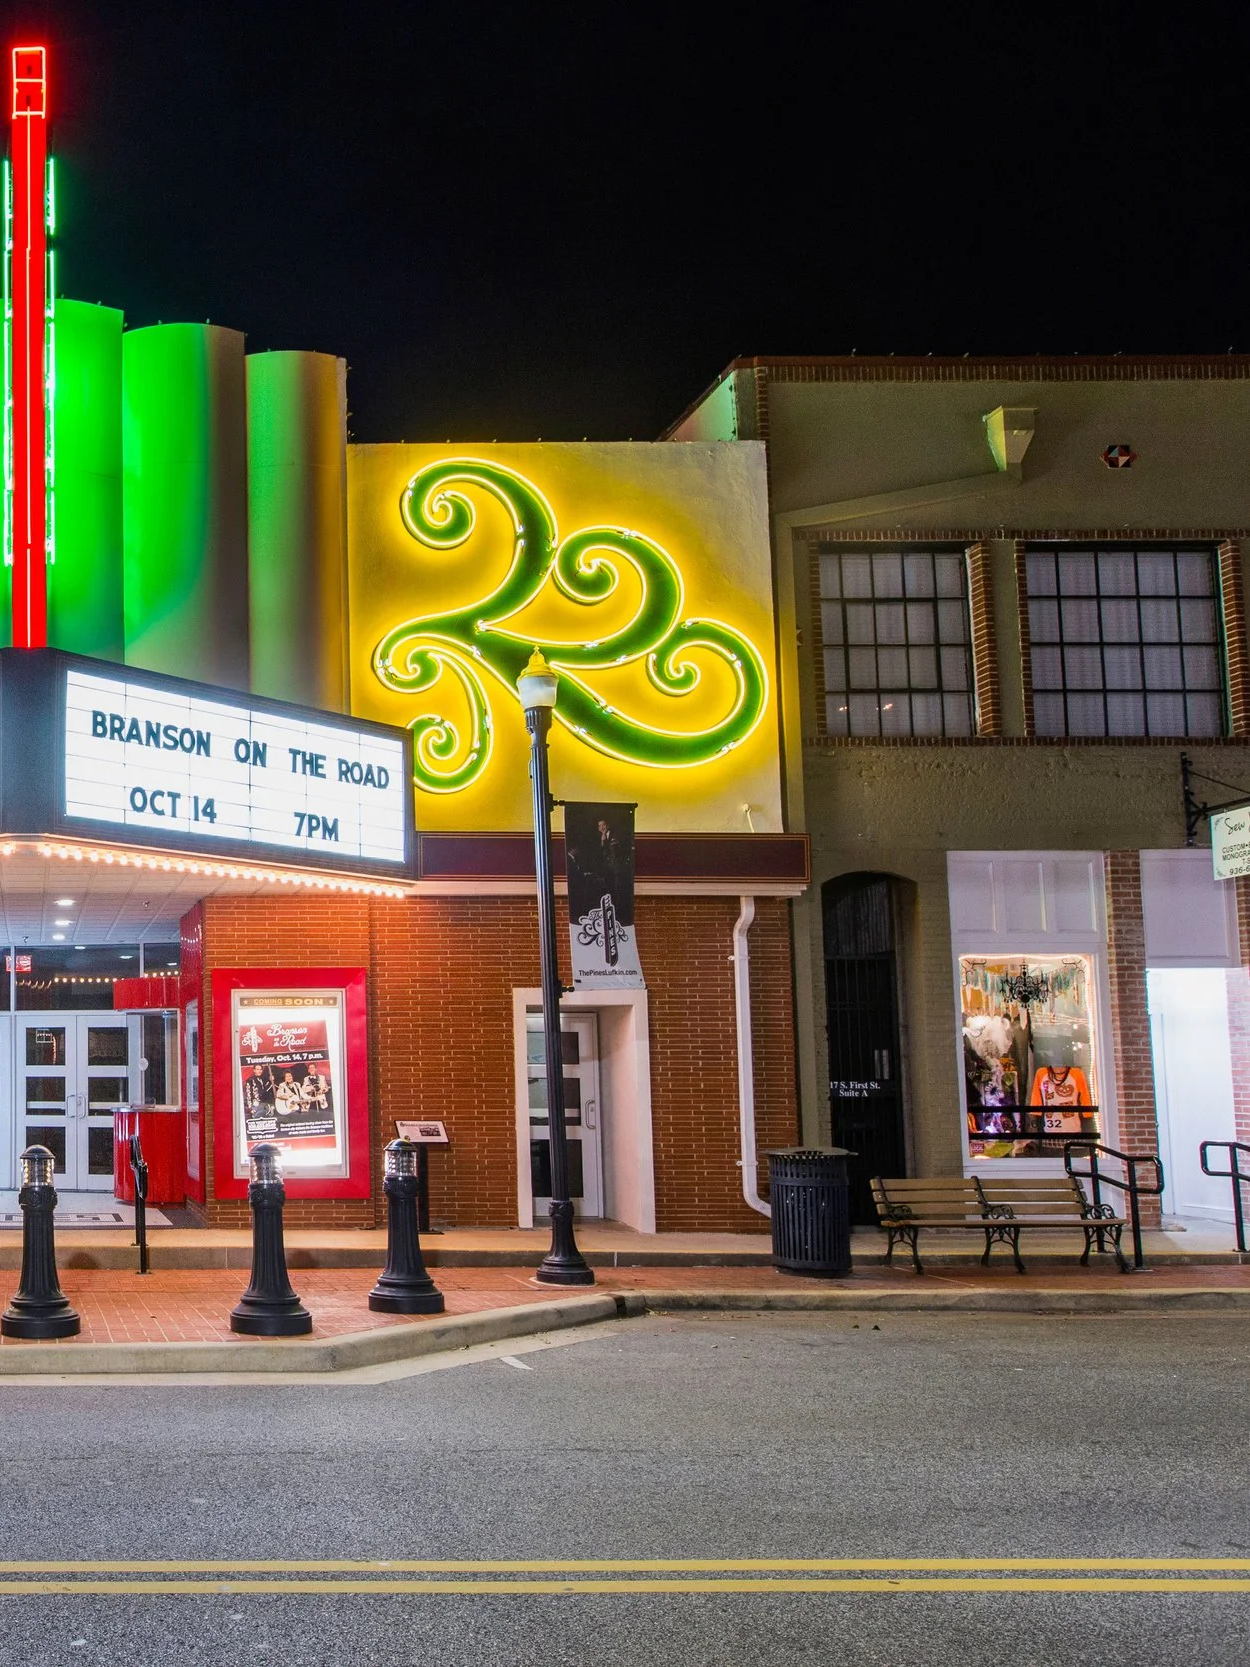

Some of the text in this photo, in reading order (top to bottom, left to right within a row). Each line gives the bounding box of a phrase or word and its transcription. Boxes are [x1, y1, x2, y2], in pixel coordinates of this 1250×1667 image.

[91, 711, 390, 789] BRANSON ON THE ROAD
[129, 787, 339, 842] OCT 14 7PM
[1224, 817, 1246, 835] Sew
[606, 911, 617, 956] PINES
[578, 969, 638, 977] ThePinesLufkin.com
[254, 998, 324, 1006] COMING SOON
[840, 1081, 848, 1089] S.
[850, 1081, 868, 1089] First
[870, 1081, 881, 1089] St.
[839, 1089, 868, 1097] Suite A
